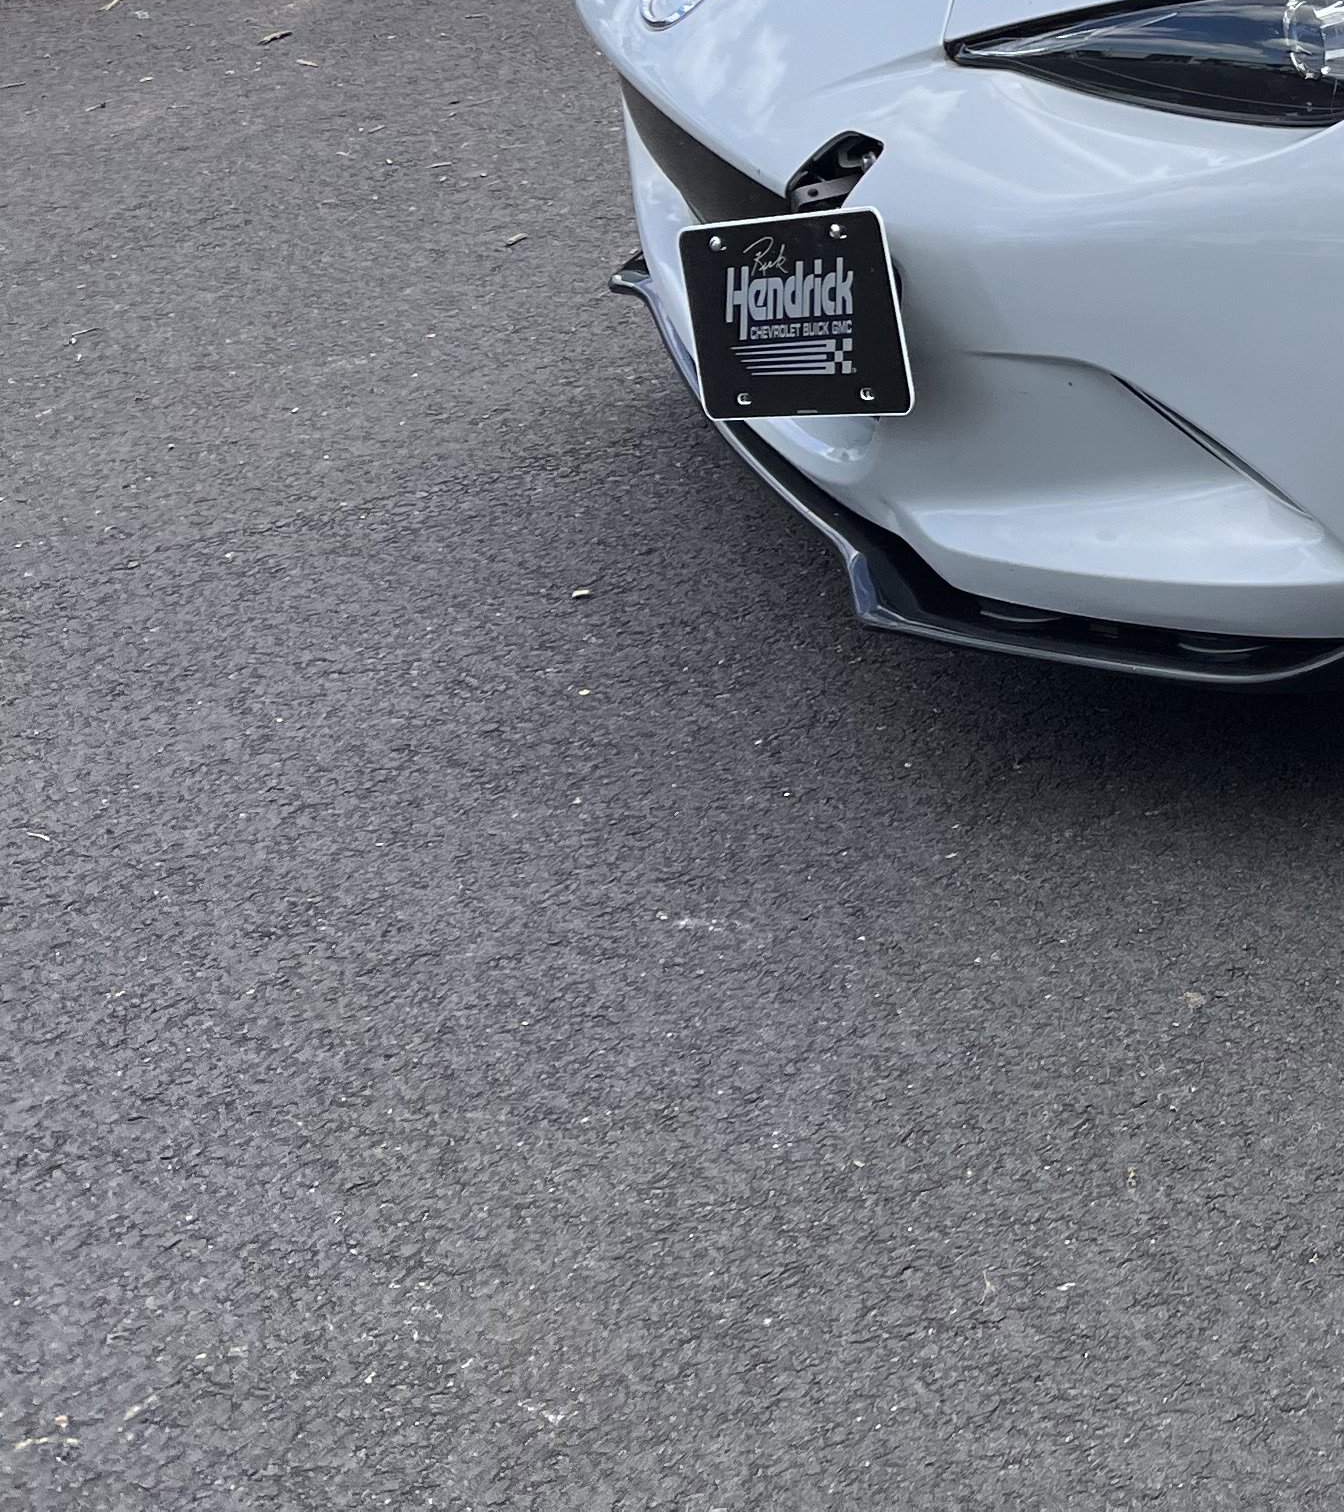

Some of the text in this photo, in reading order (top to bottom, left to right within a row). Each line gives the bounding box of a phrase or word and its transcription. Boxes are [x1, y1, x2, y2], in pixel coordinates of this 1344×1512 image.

[725, 256, 854, 341] Hendrick
[749, 319, 853, 341] CHEVROLET BUICK GMC
